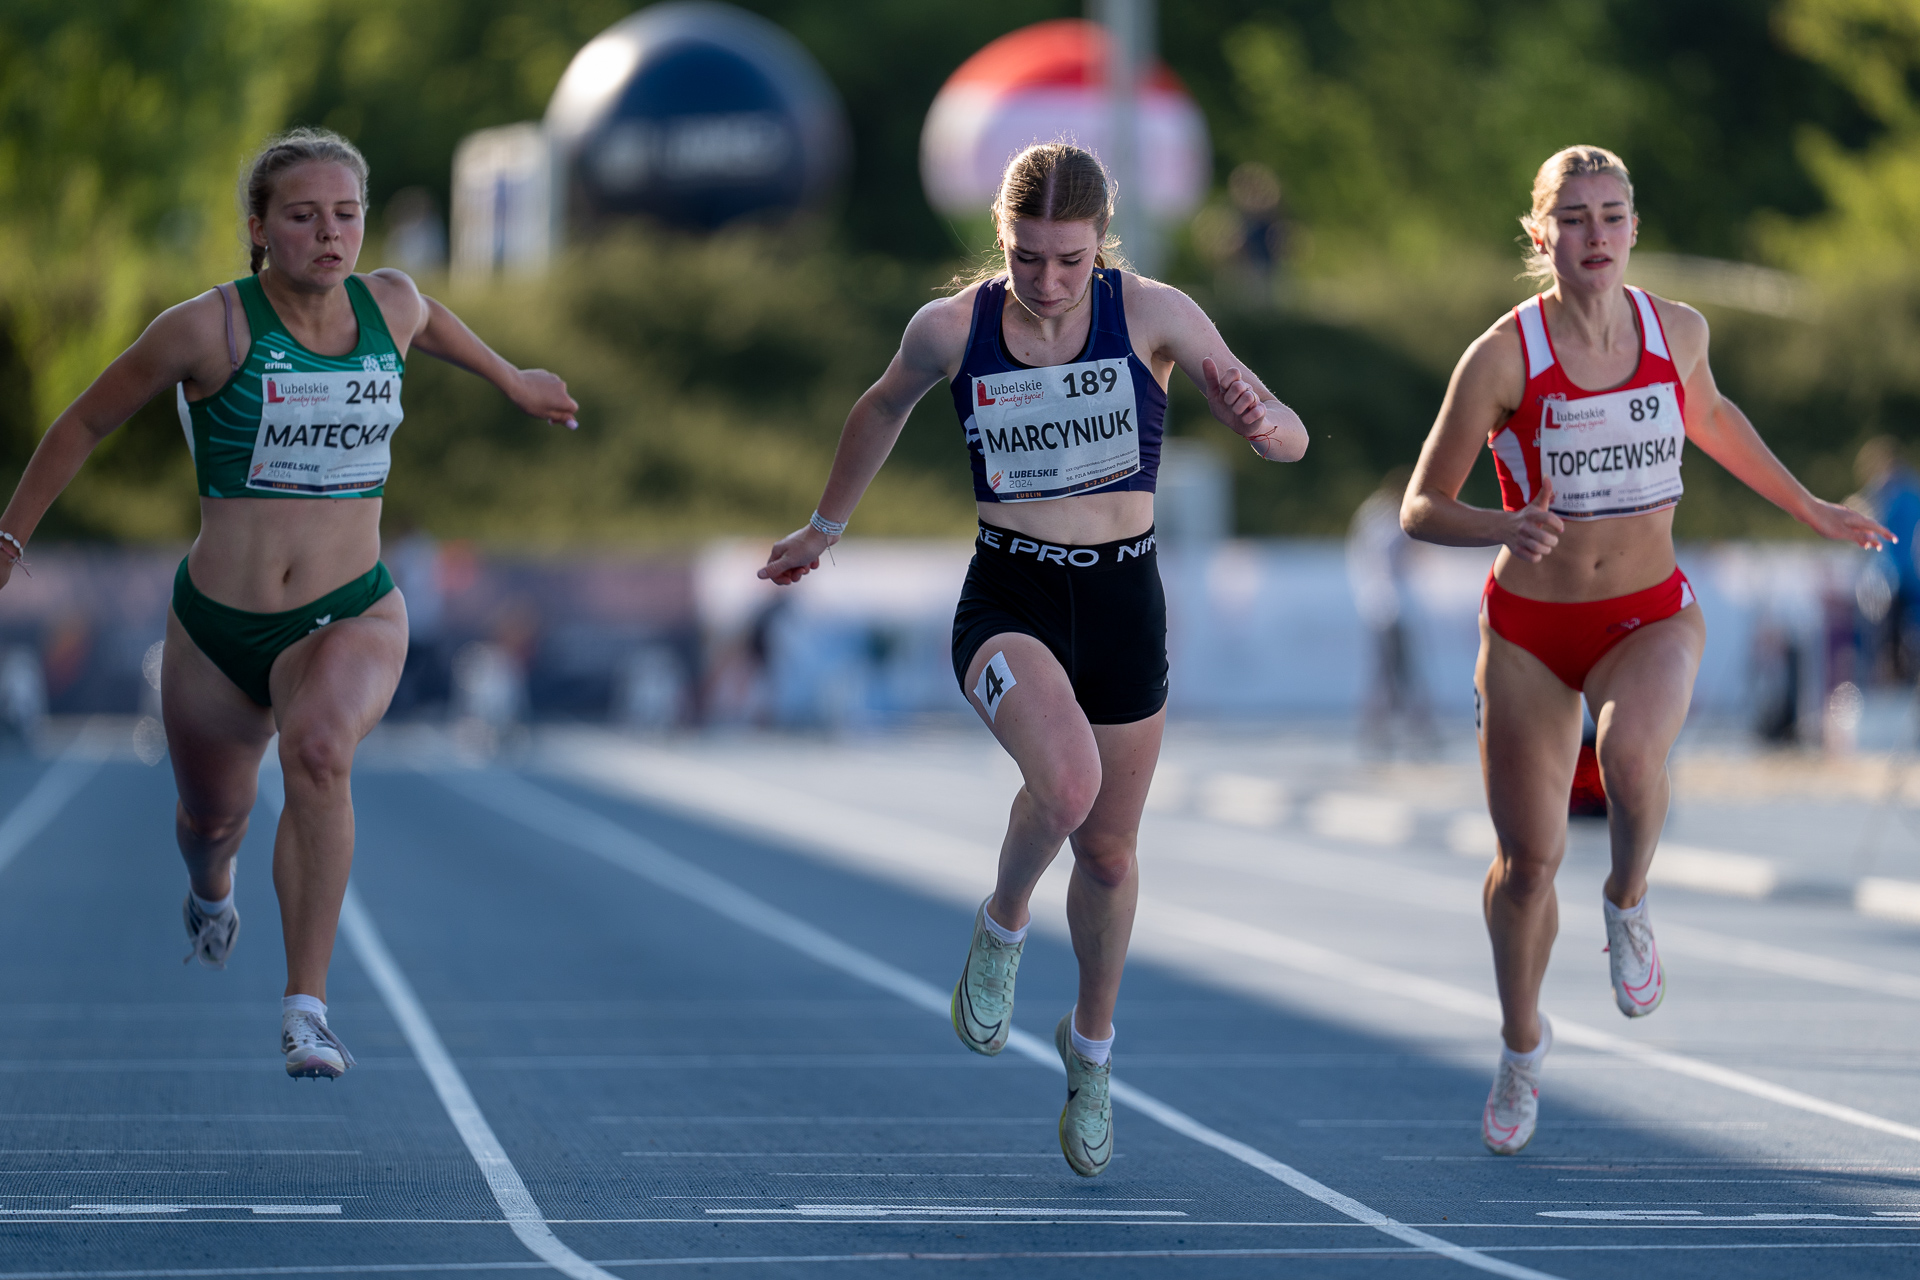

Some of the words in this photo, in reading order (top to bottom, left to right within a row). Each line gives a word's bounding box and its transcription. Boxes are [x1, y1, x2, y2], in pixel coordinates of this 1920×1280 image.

[265, 361, 292, 370] erima
[280, 383, 329, 394] lubelskie
[990, 380, 1042, 395] lubelskie
[1062, 367, 1118, 399] 189
[345, 380, 392, 405] 244
[1556, 407, 1605, 422] lubelskie
[1629, 396, 1660, 422] 89
[263, 424, 390, 450] MATECKA
[985, 408, 1134, 454] MARCYNIUK
[1547, 436, 1677, 476] TOPCZEWSKA
[267, 469, 291, 478] 2024
[269, 461, 320, 473] LUBELSKIE
[1009, 468, 1058, 478] LUBELSKIE
[1009, 479, 1033, 489] 2024
[1562, 488, 1612, 500] LUBELSKIE
[1009, 537, 1100, 568] PRO
[985, 664, 1004, 707] 4
